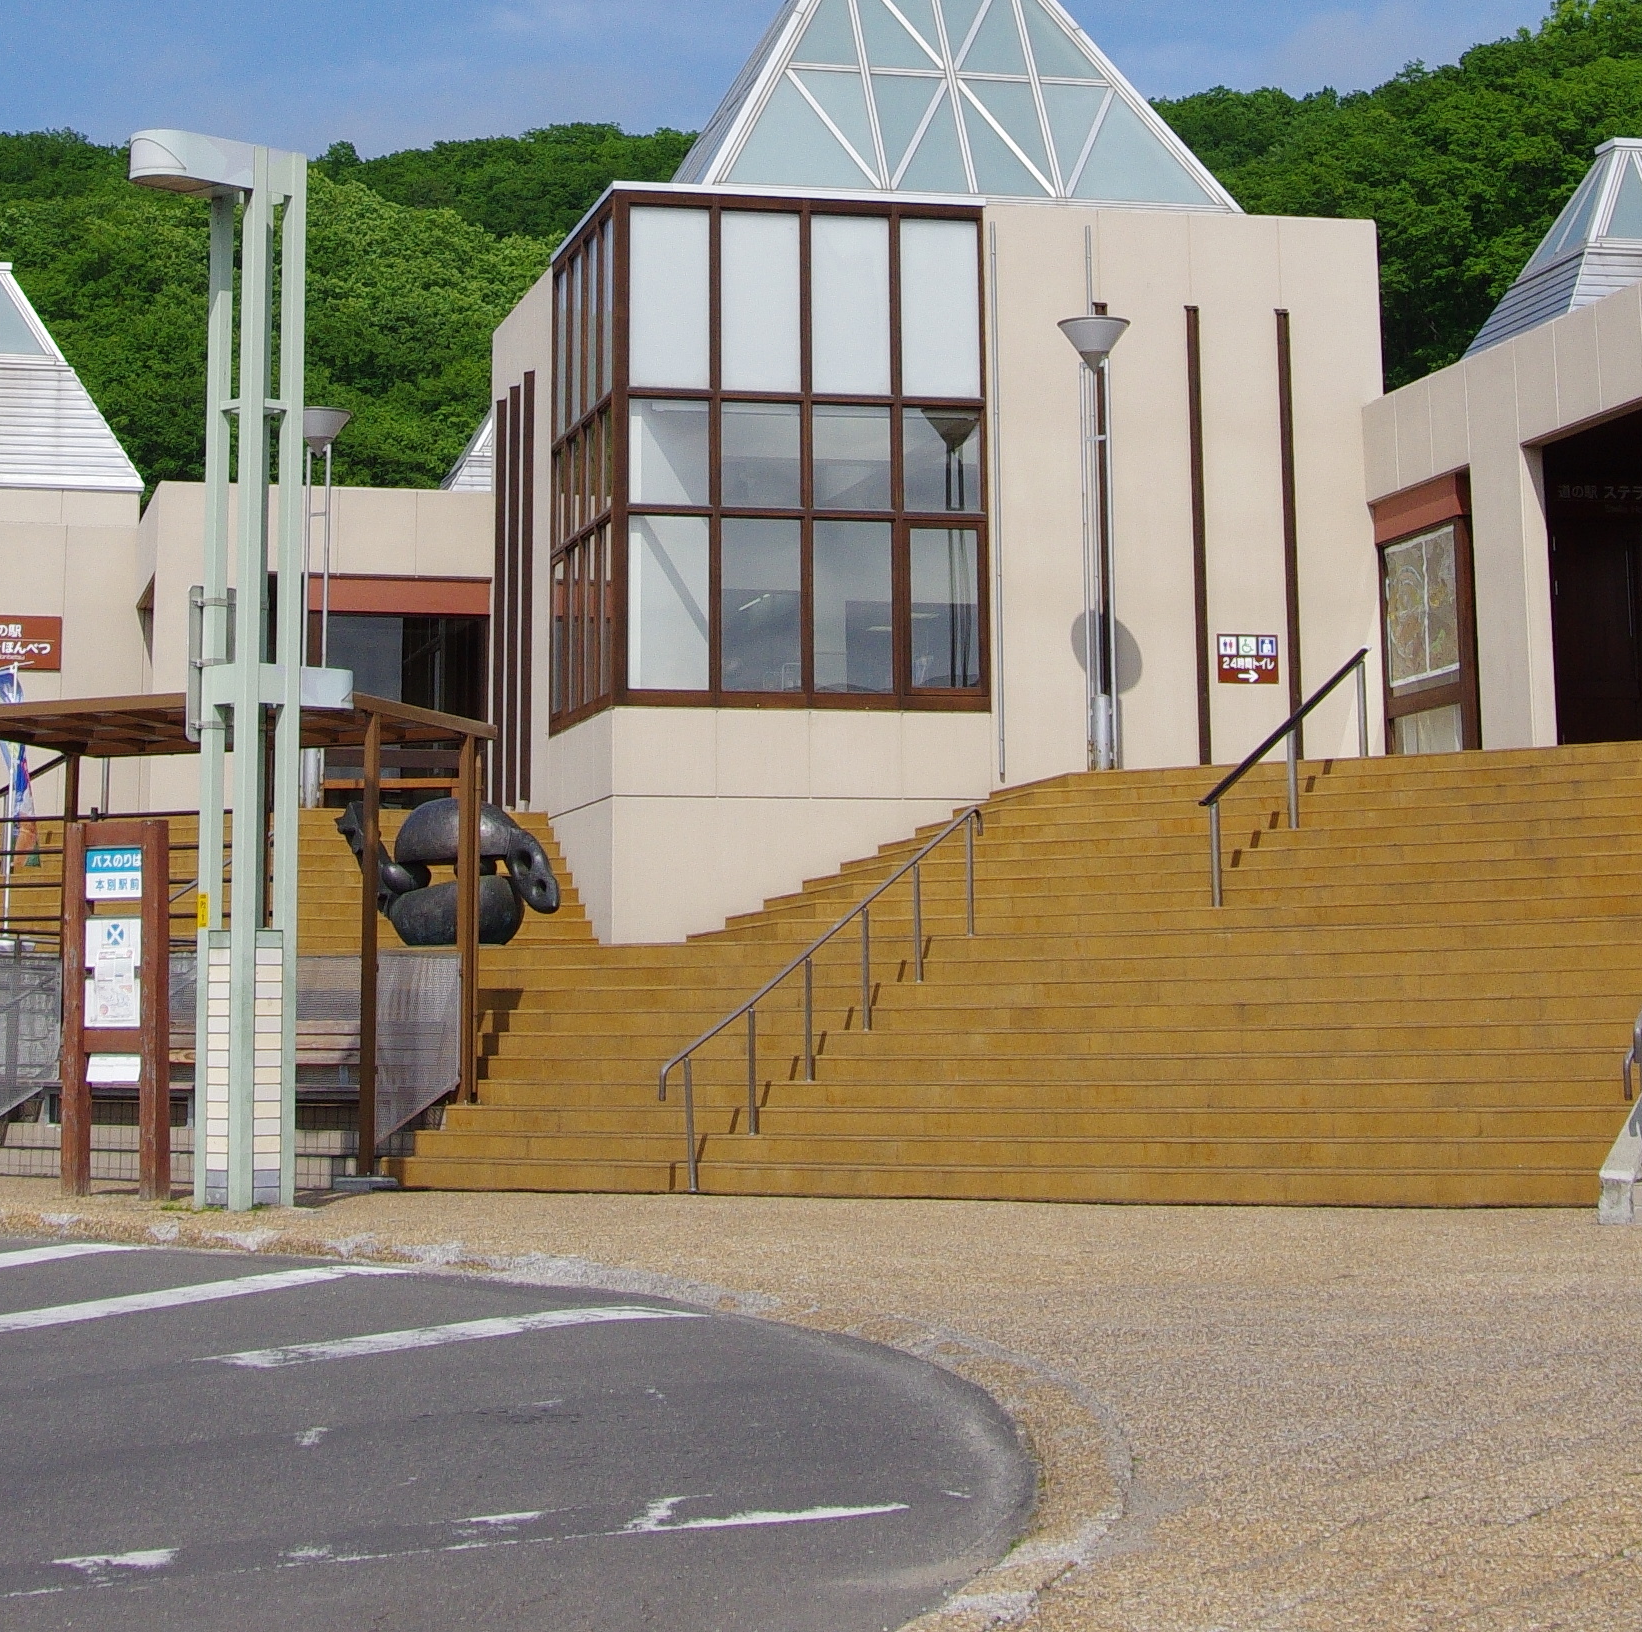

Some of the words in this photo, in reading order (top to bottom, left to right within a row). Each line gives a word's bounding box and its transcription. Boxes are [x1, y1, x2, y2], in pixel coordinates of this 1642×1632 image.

[1557, 484, 1598, 500] 道の駅
[1222, 656, 1275, 670] 24時間トイレ
